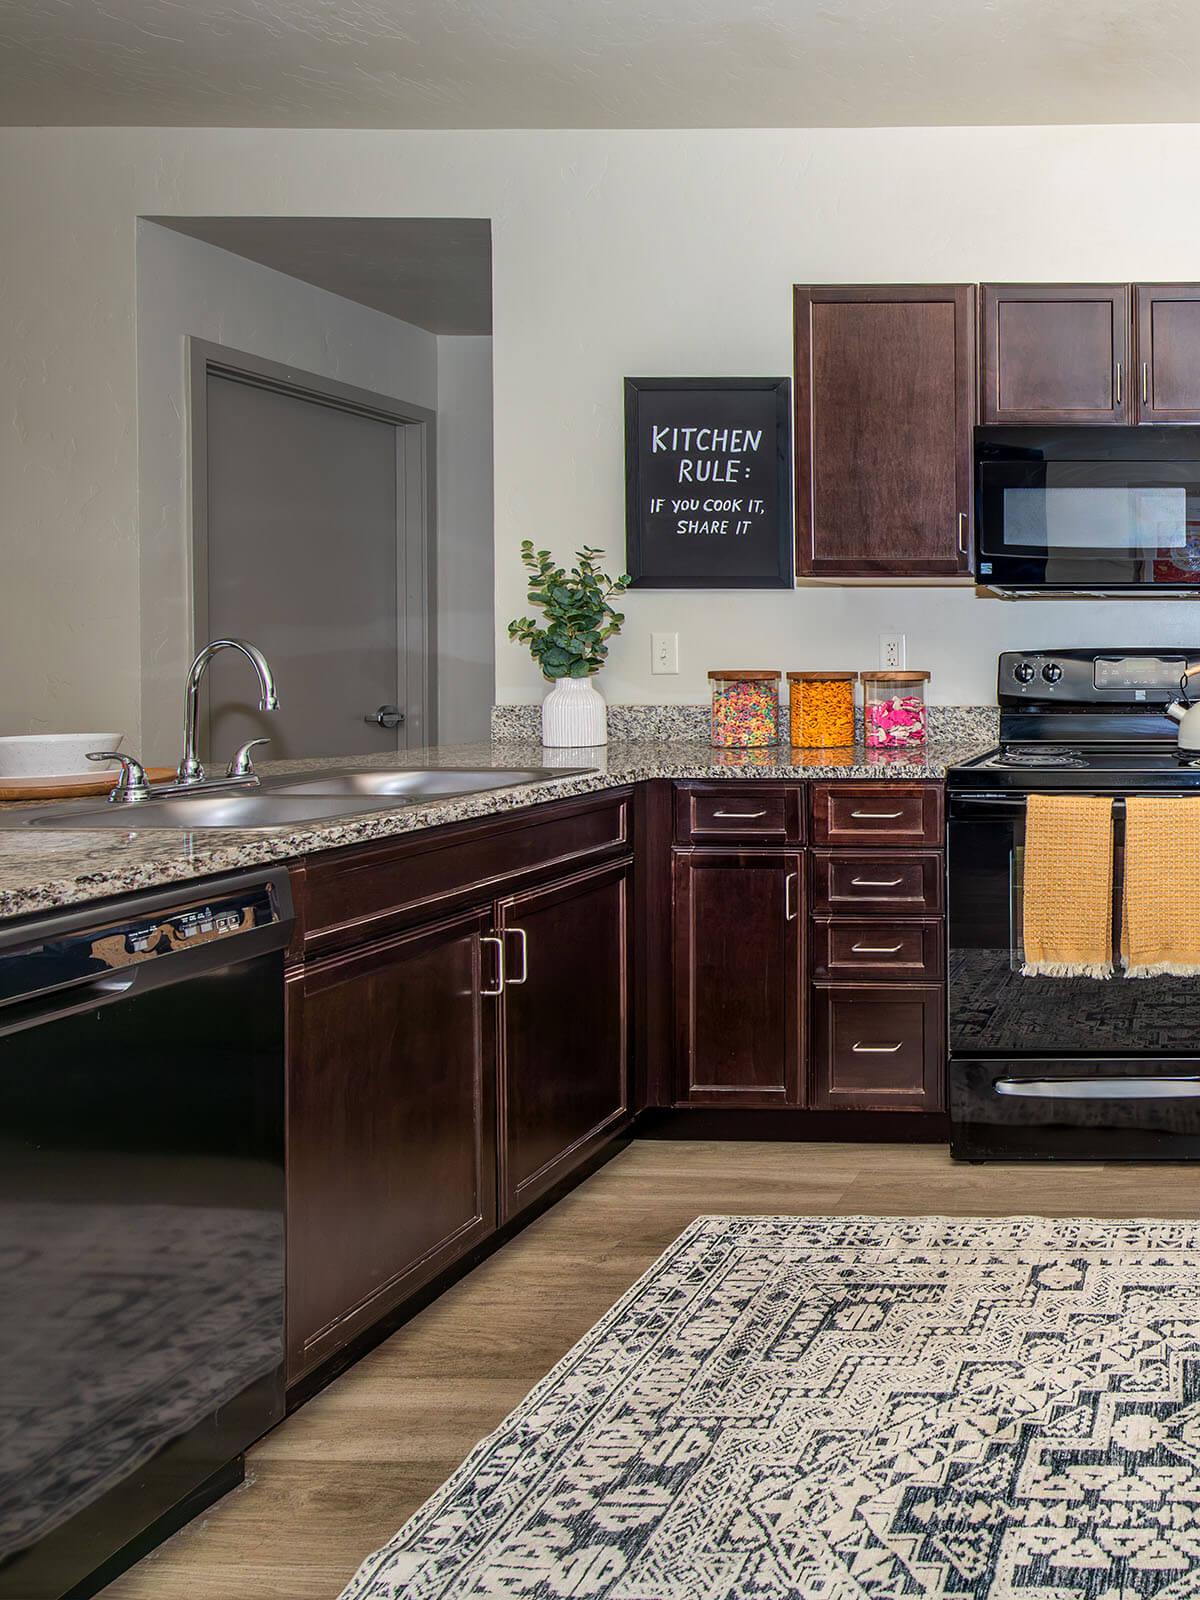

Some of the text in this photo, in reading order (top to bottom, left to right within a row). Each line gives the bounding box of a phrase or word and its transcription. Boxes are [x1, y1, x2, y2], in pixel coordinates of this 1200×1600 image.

[652, 425, 762, 453] KITCHEN
[678, 459, 751, 483] RULE:
[650, 499, 765, 515] IF YOU COOK IT,
[677, 520, 752, 535] SHARE IT
